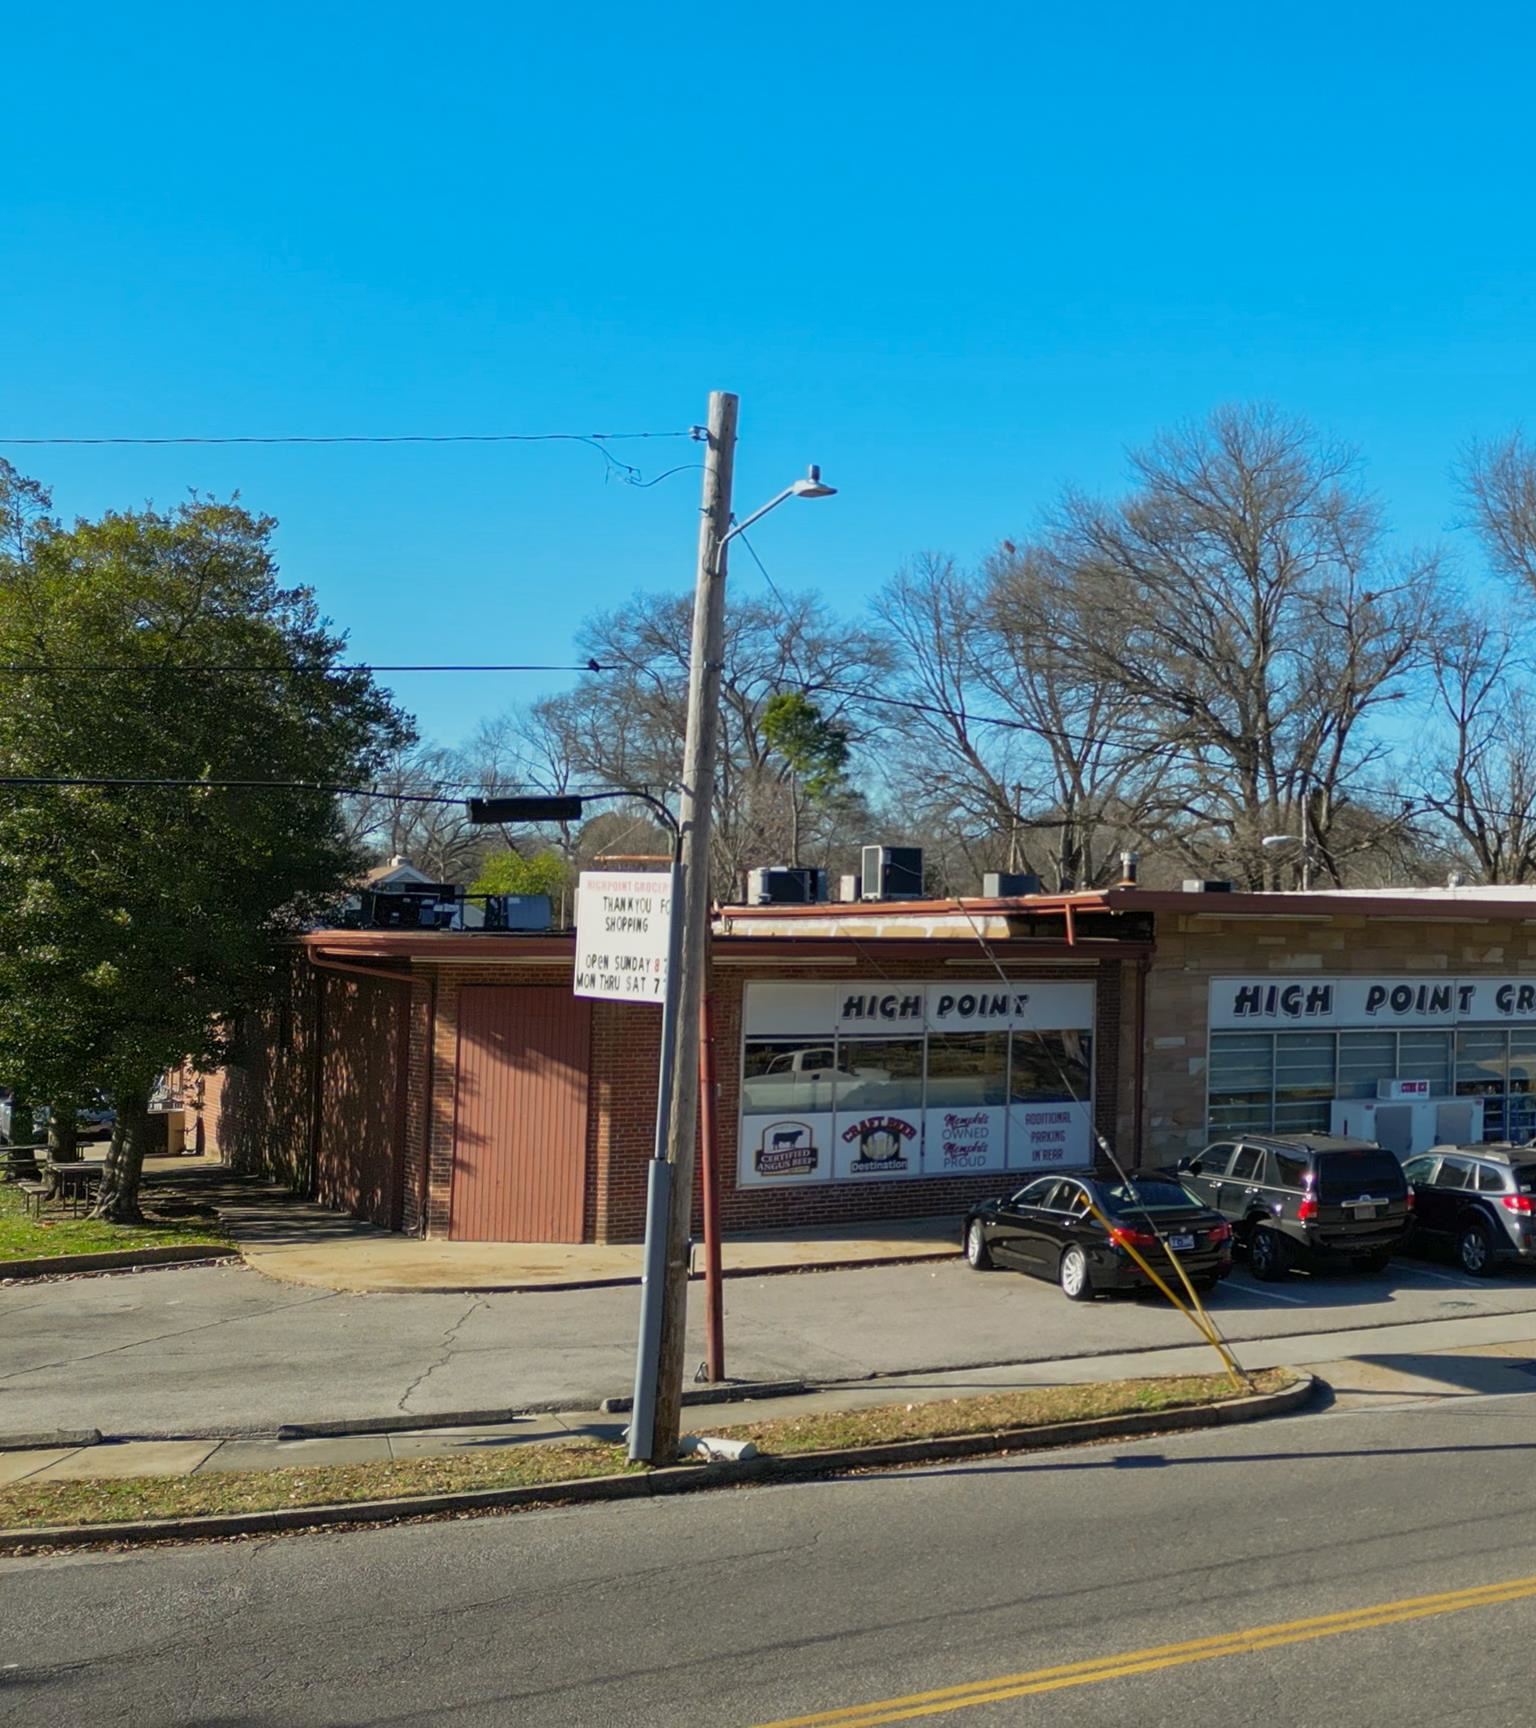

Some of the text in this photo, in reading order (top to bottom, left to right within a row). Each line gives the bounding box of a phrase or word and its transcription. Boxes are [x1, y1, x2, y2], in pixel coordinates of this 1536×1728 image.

[634, 881, 669, 894] GROCER
[660, 898, 671, 915] FO
[605, 916, 648, 932] SHOPPING
[615, 955, 651, 973] SUNDAY
[576, 973, 596, 990] MON
[600, 974, 620, 990] THRU
[626, 976, 645, 992] SAT
[842, 994, 1030, 1021] HIGH POINT
[1233, 985, 1334, 1018] HIGH
[1365, 985, 1475, 1015] POINT
[1025, 1112, 1071, 1125] ADDITIONAL
[942, 1127, 989, 1140] OWNED
[1031, 1130, 1066, 1143] PARKING
[761, 1149, 811, 1163] CERTIFIED
[1042, 1149, 1063, 1161] REAR
[758, 1159, 791, 1171] ANGUS
[852, 1160, 907, 1172] Destination
[944, 1156, 986, 1168] PROUD
